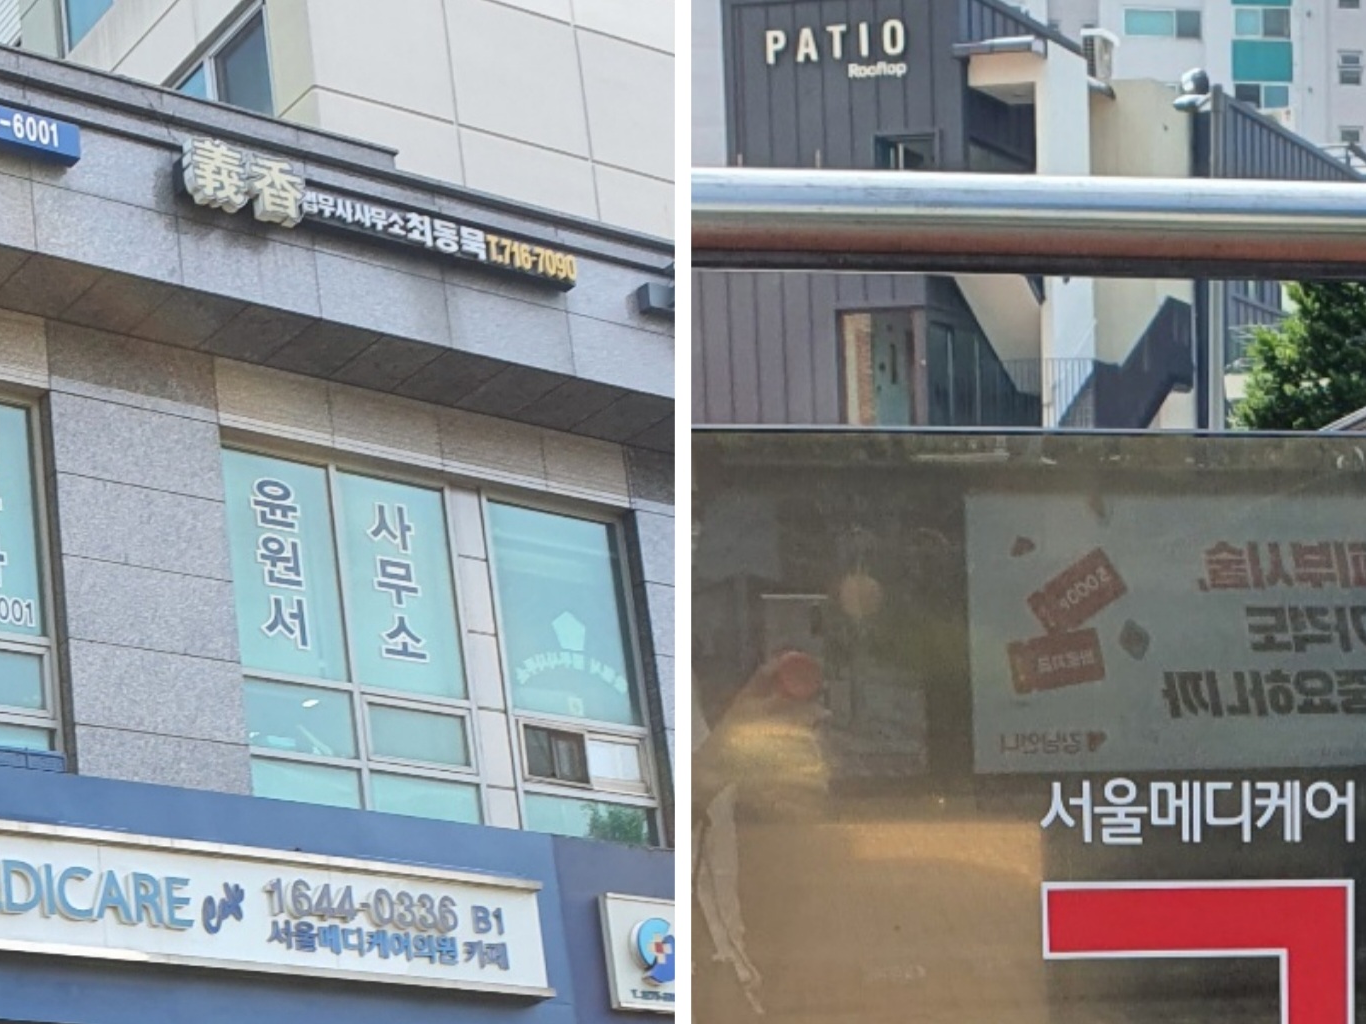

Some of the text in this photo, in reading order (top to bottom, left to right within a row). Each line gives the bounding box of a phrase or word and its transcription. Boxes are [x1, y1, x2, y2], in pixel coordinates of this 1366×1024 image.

[765, 18, 907, 65] PATIO
[847, 60, 907, 81] Rooftop
[485, 233, 578, 281] T.716-7090
[250, 477, 311, 651] 윤원서
[367, 503, 430, 664] 사무소
[1039, 777, 1356, 847] 서울메디케어
[262, 876, 459, 936] 1644-0336
[471, 904, 505, 937] B1
[462, 939, 510, 972] 카페
